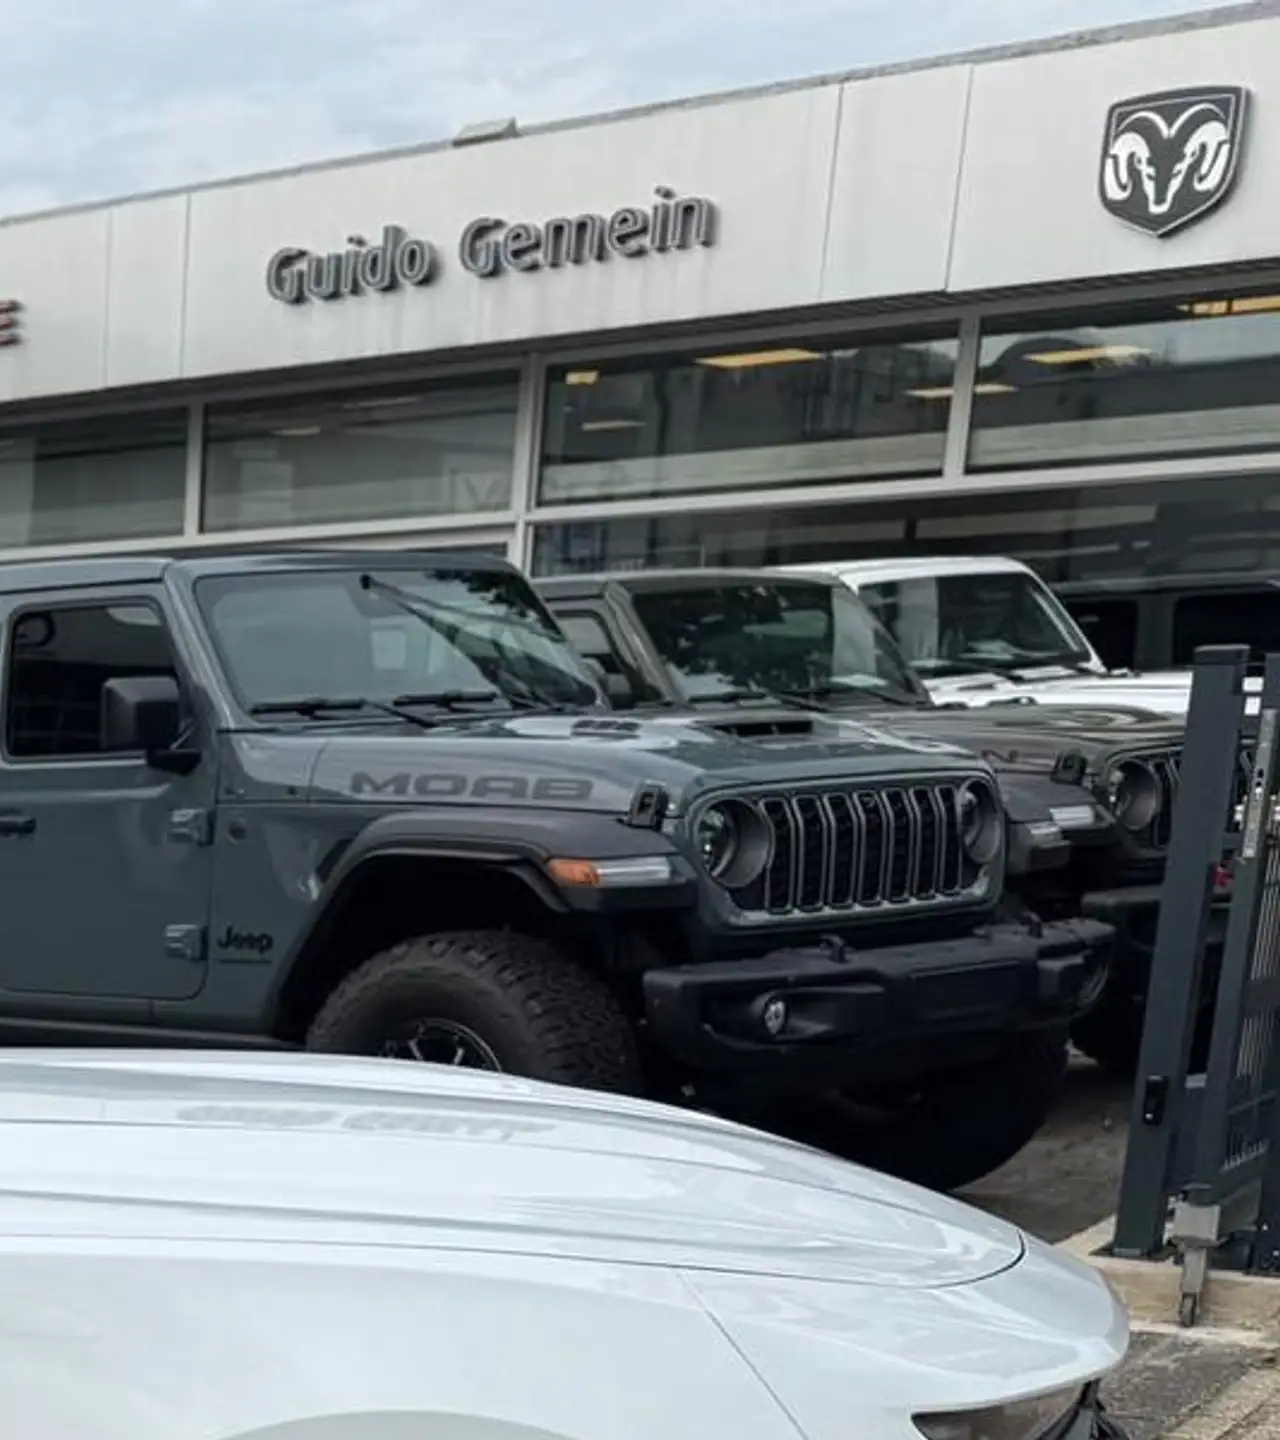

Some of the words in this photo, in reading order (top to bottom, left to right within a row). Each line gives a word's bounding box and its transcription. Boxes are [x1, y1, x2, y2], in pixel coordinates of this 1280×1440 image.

[267, 226, 438, 304] Guido
[459, 184, 720, 278] Gemein
[352, 771, 593, 800] MOAB
[217, 925, 274, 954] Jeep
